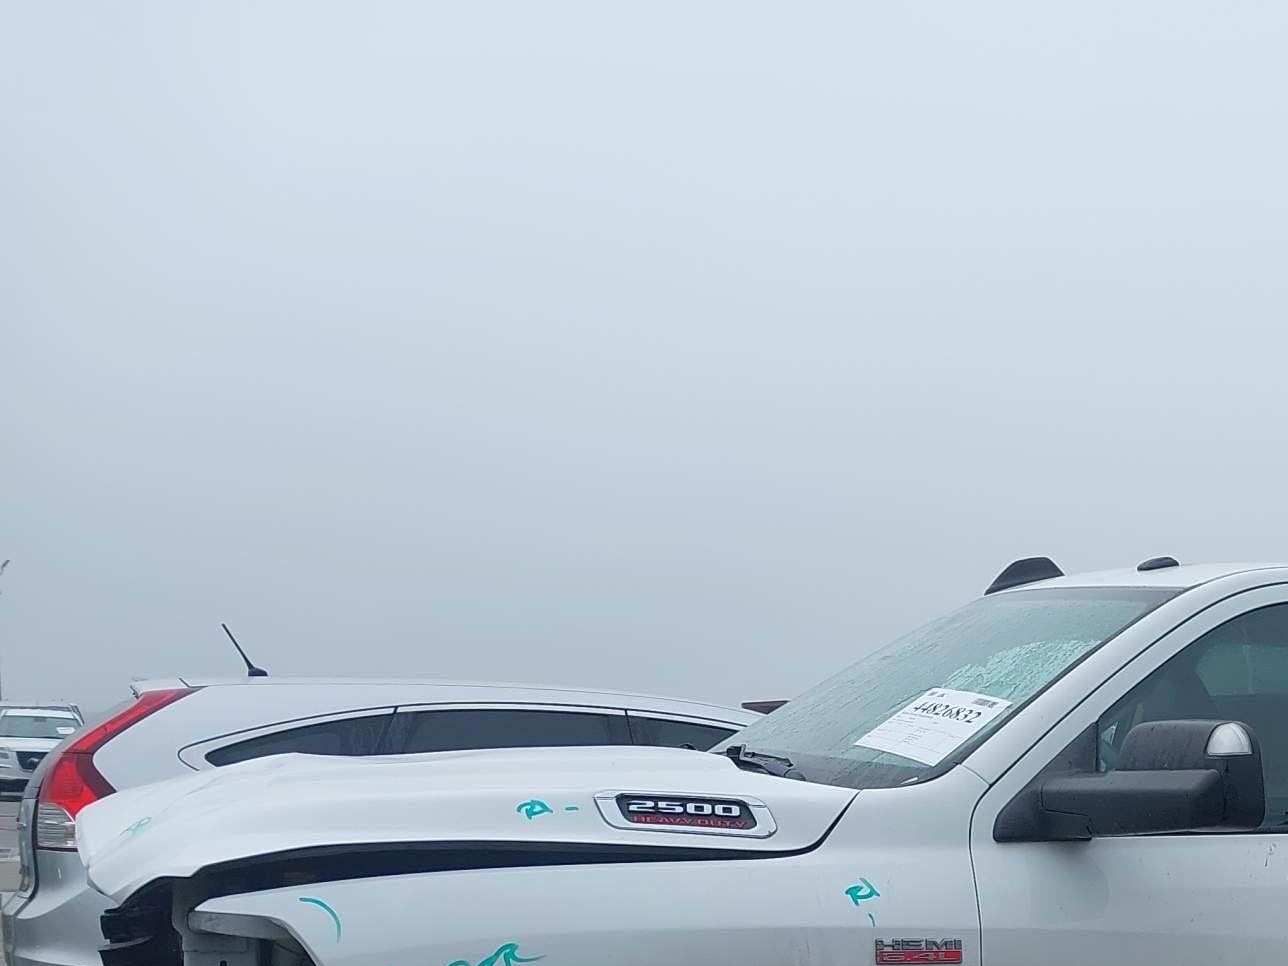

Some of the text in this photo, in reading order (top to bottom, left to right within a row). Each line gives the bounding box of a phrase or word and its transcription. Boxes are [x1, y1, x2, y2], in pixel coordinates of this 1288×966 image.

[913, 702, 982, 723] 44826832
[627, 800, 741, 816] 2500
[875, 939, 962, 951] HEMI
